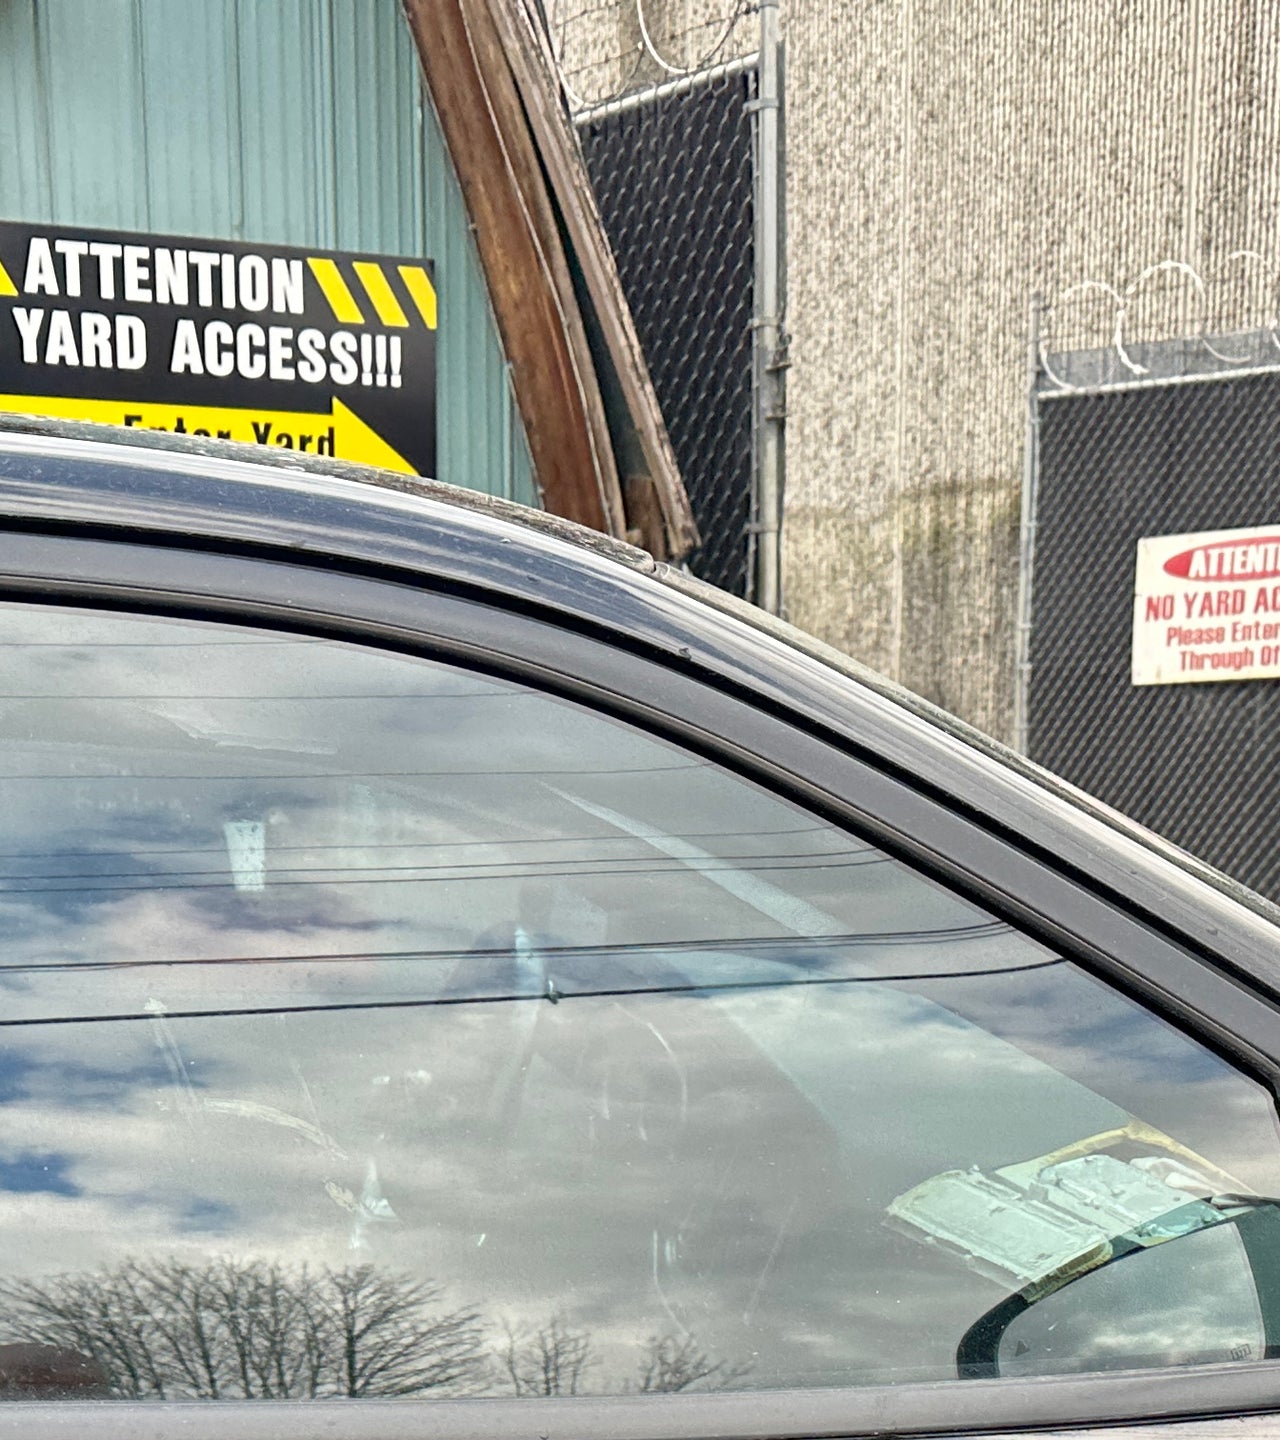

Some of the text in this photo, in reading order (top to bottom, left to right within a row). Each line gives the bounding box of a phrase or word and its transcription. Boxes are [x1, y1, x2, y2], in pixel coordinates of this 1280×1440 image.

[23, 237, 305, 315] ATTENTION
[11, 307, 147, 371] YARD
[170, 318, 402, 389] ACCESS!!!
[1145, 594, 1175, 622] NO
[1184, 588, 1246, 618] YARD
[1166, 626, 1225, 647] Please
[1179, 647, 1254, 672] Through
